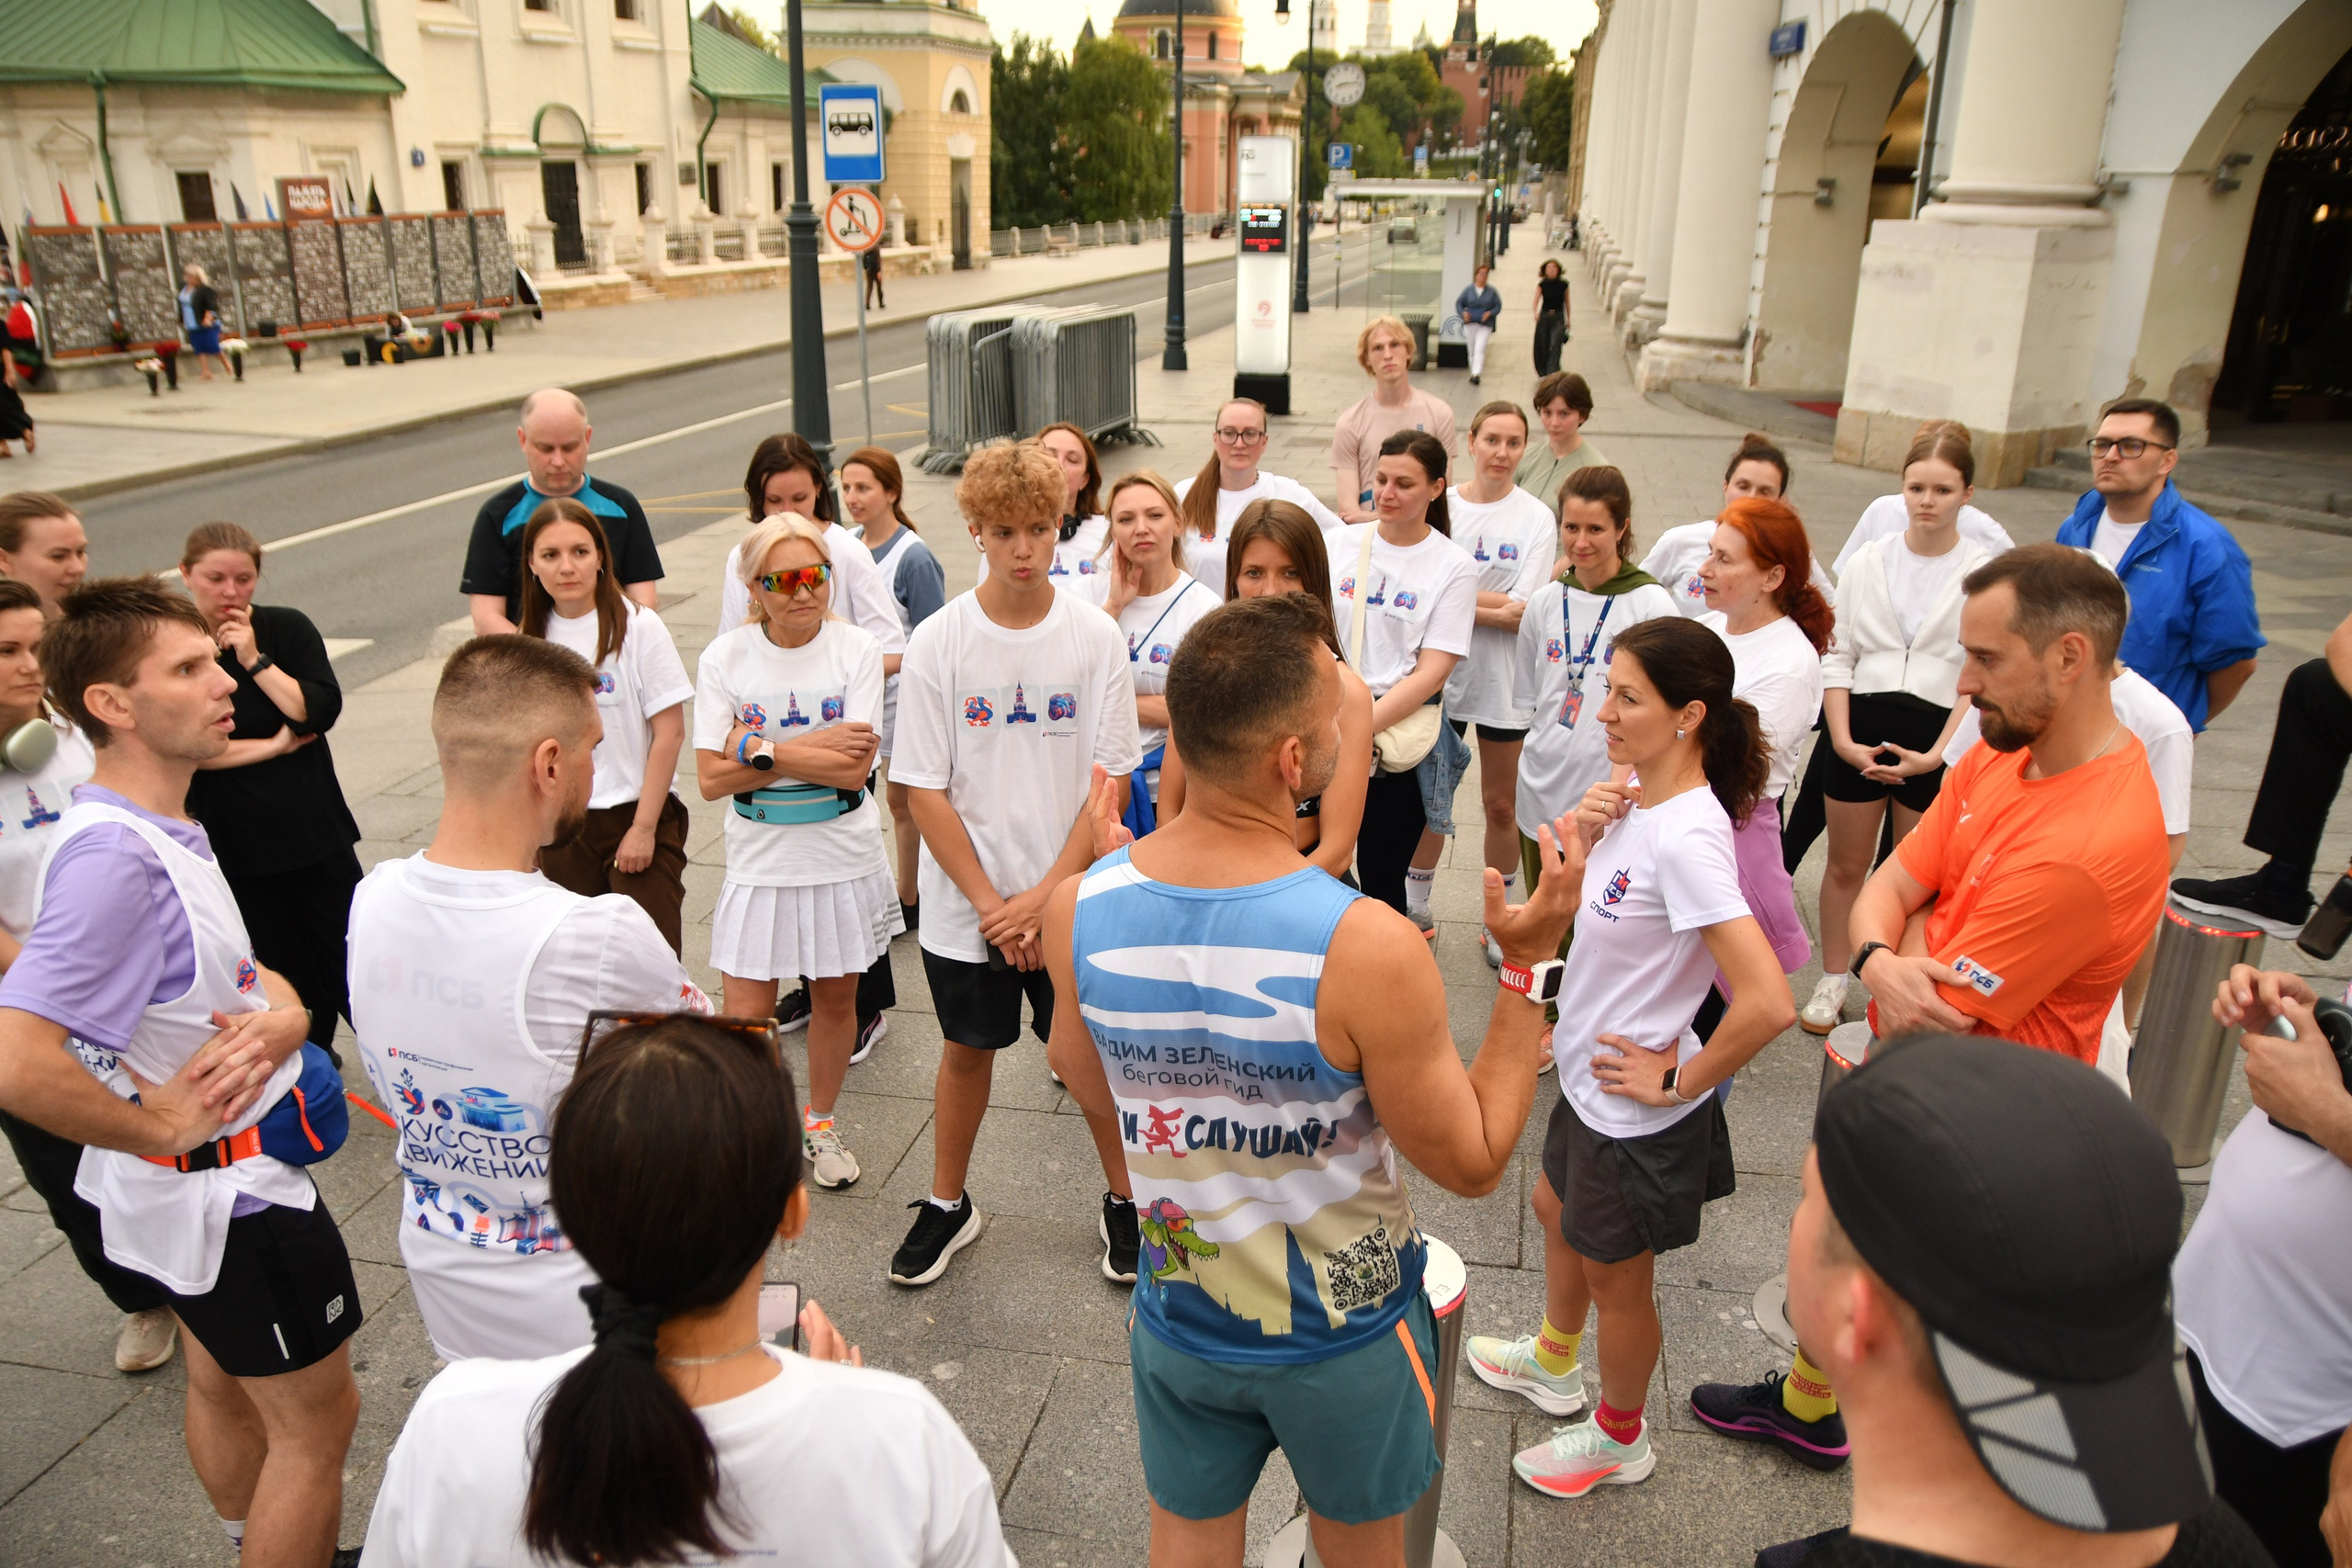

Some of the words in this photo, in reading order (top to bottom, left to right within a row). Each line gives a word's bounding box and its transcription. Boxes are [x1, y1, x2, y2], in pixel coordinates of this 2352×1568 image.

[1331, 145, 1345, 164] P
[1589, 900, 1620, 923] СПОРТ
[412, 968, 485, 1010] ПСБ
[1968, 969, 1995, 989] ПСБ
[398, 1050, 419, 1063] ПСБ
[1092, 1027, 1158, 1063] ВАДИМ
[1164, 1045, 1316, 1082] ЗЕЛЕНСКИЙ
[1122, 1063, 1219, 1088] беговой
[1224, 1077, 1264, 1100] гид
[1184, 1113, 1340, 1159] СЛУШАЙ!
